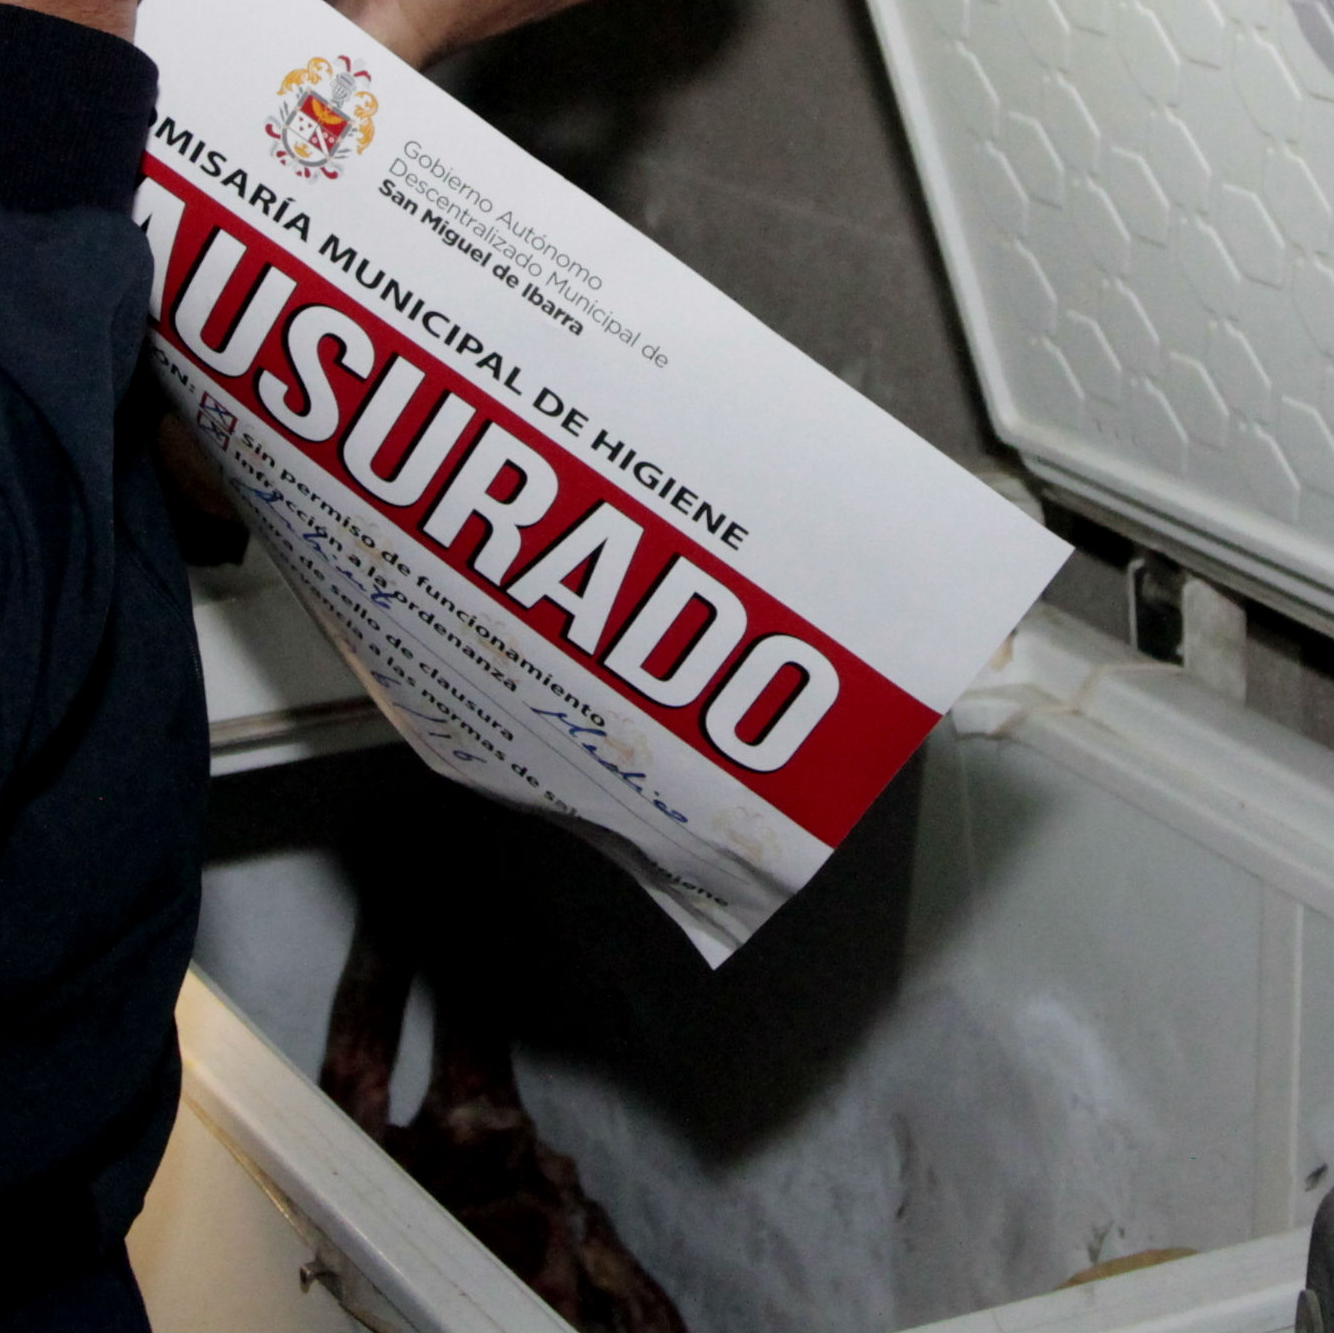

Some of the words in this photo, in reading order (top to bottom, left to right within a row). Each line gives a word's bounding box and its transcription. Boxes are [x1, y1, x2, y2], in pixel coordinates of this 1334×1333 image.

[378, 178, 419, 216] San
[419, 209, 494, 268] Miguel
[492, 263, 520, 289] de
[521, 283, 585, 336] Ibarra
[388, 157, 543, 278] Descentralizado
[545, 271, 642, 347] Municipal
[641, 343, 668, 369] de
[403, 140, 493, 214] Gobierno
[495, 211, 603, 292] Autónomo
[318, 233, 524, 396] MUNICIPAL
[532, 386, 590, 438] DE
[591, 429, 749, 552] HIGIENE
[234, 450, 344, 553] Infracción
[348, 553, 362, 567] a
[367, 567, 388, 588] la
[392, 590, 518, 693] ordenanza
[240, 431, 275, 468] Sin
[279, 468, 376, 549] permiso
[381, 549, 411, 576] de
[416, 575, 607, 728] funcionamiento
[299, 555, 325, 582] de
[330, 584, 381, 632] sello
[386, 633, 415, 660] de
[419, 661, 515, 742] clausura
[368, 641, 382, 656] a
[386, 656, 417, 687] las
[421, 689, 506, 762] normas
[510, 762, 540, 789] de
